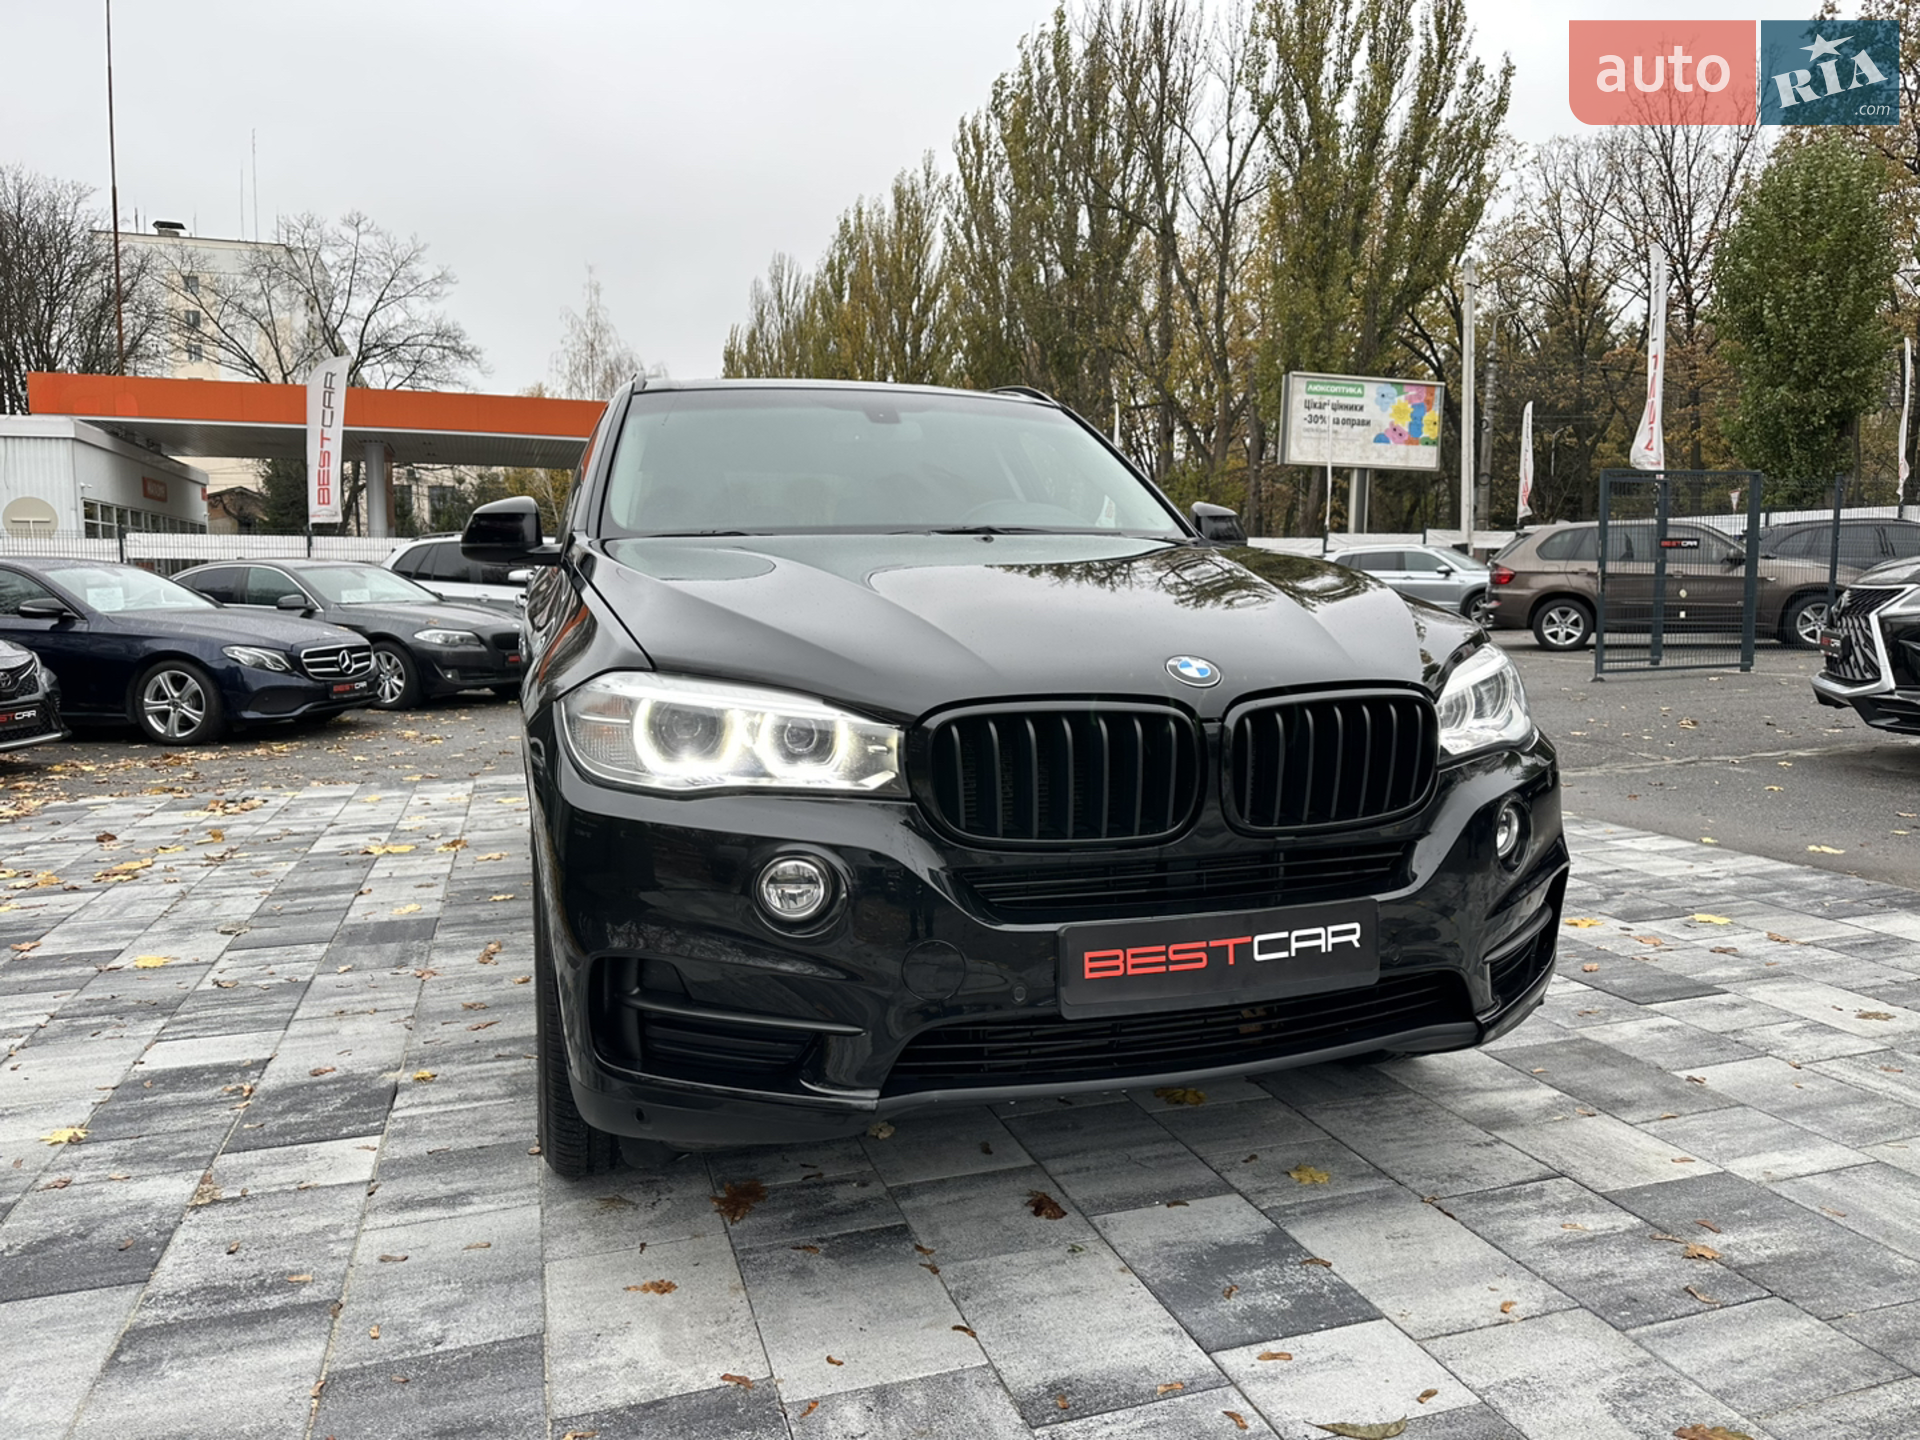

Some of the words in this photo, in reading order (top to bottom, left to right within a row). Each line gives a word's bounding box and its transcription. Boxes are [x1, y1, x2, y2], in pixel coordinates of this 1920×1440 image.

[1307, 384, 1363, 395] ЛЮКСОПТИКА
[1331, 400, 1364, 412] цінники
[1303, 414, 1327, 425] -30%
[1341, 417, 1371, 429] оправи
[317, 371, 337, 506] BESTCAR
[1084, 922, 1361, 979] BESTCAR
